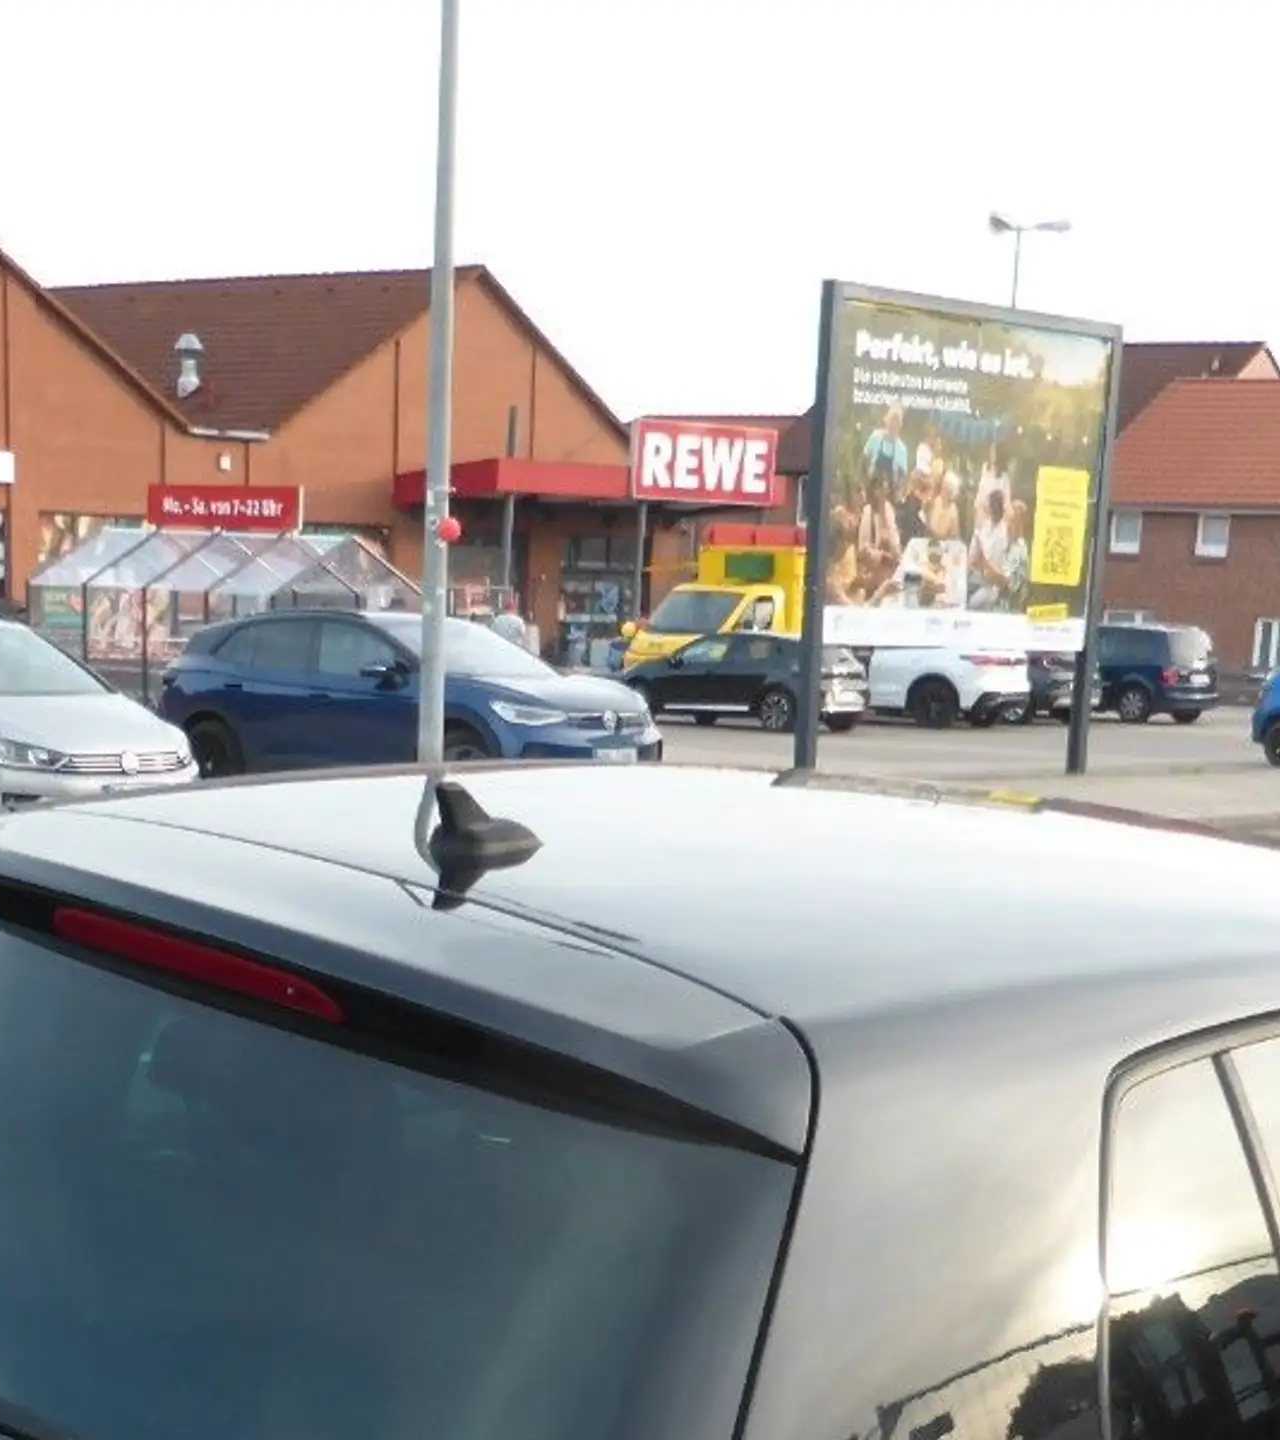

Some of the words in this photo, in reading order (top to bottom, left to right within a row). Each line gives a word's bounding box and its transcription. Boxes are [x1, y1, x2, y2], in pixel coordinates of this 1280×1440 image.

[855, 330, 939, 371] Perfekt,
[941, 340, 977, 371] wie
[642, 431, 769, 493] REWE
